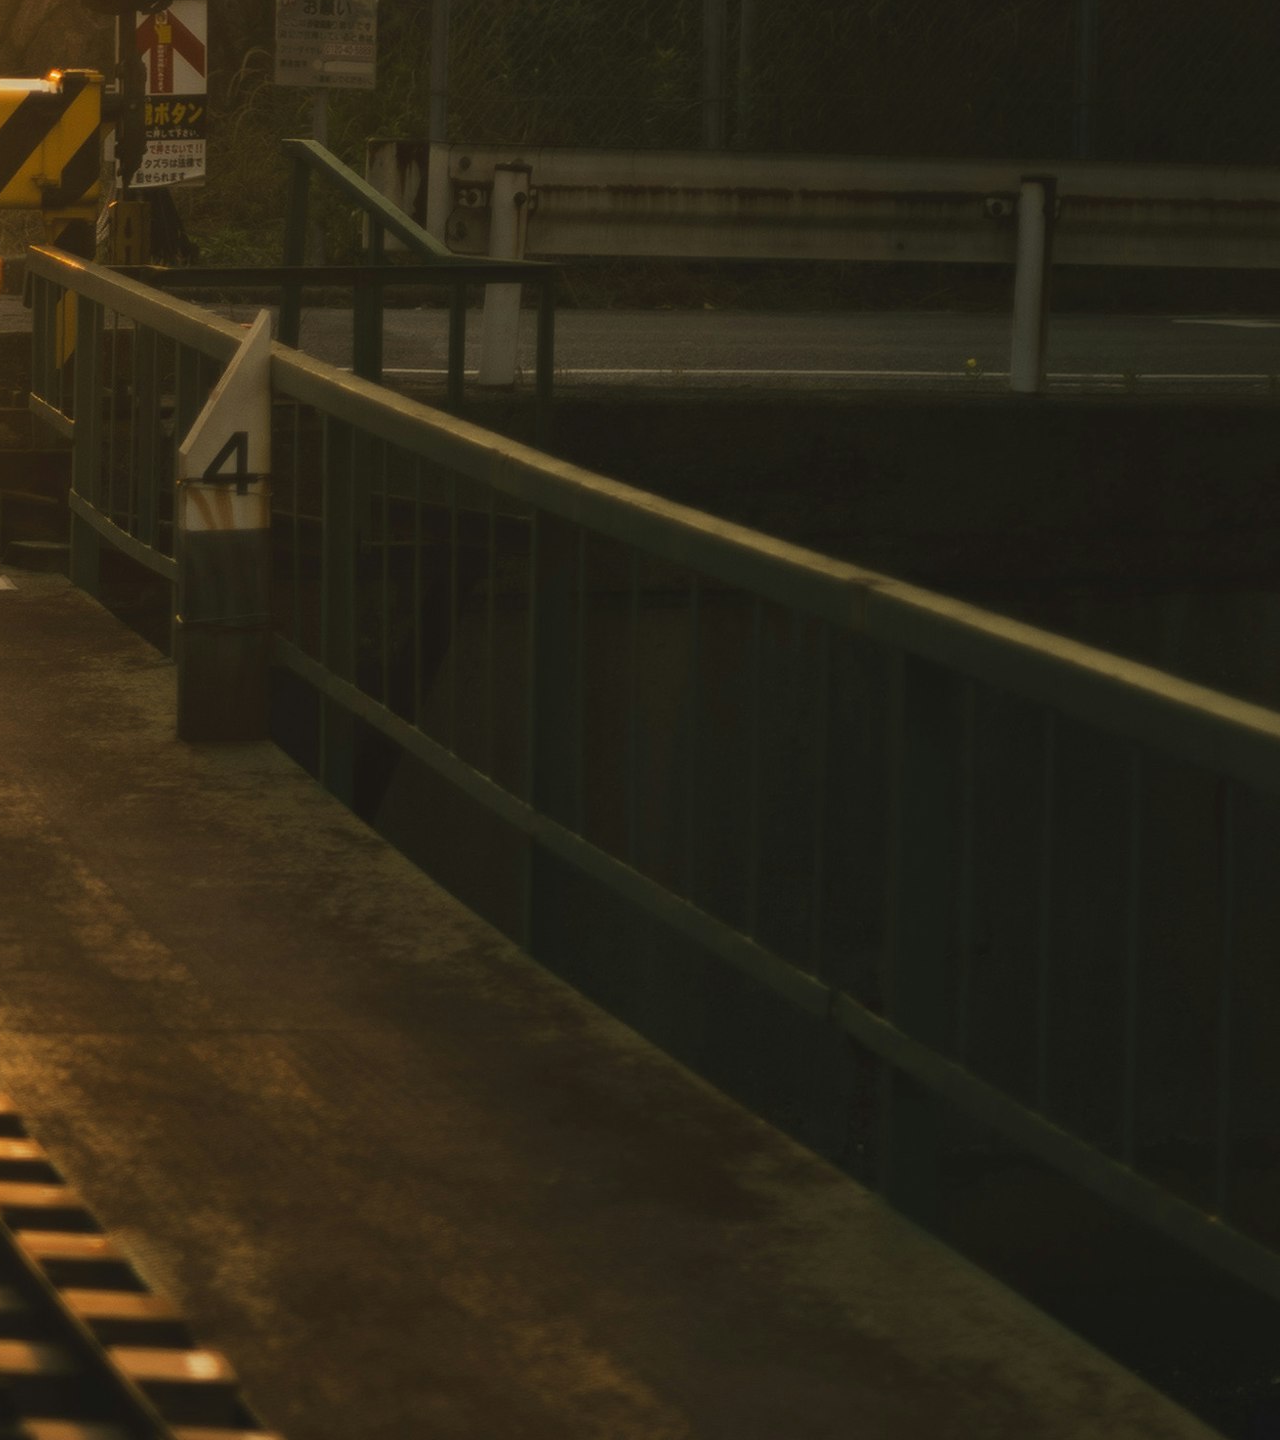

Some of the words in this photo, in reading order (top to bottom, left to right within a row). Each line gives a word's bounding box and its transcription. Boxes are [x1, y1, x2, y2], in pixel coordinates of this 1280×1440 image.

[144, 102, 203, 126] ボタン
[202, 431, 259, 496] 4
